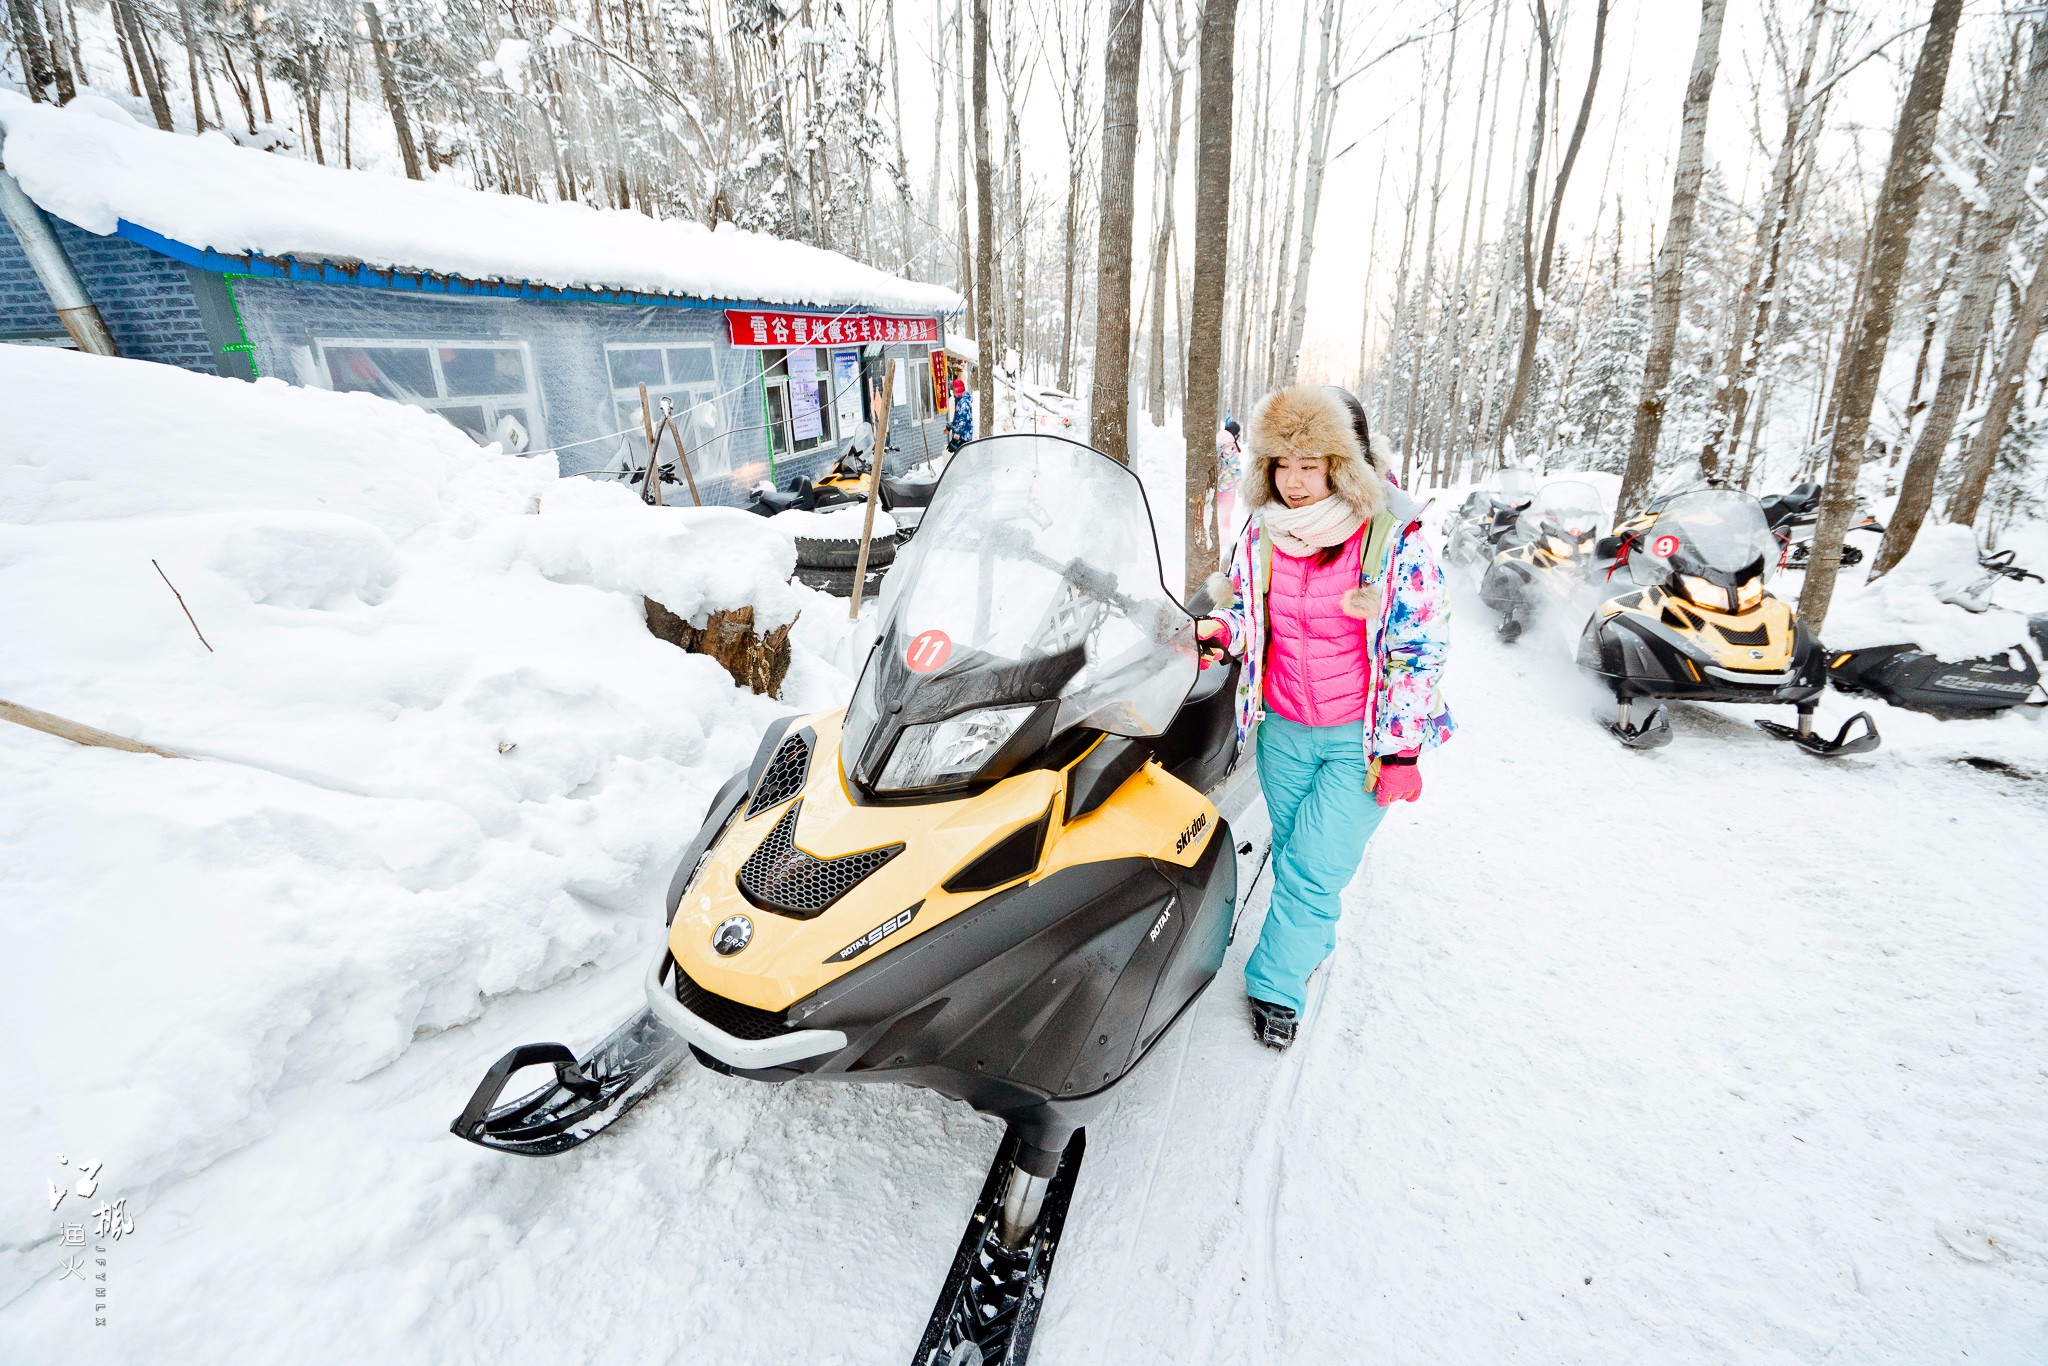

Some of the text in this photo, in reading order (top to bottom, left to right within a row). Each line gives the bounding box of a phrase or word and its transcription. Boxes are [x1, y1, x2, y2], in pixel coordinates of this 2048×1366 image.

[750, 315, 928, 343] 雪谷雪地摩托车义务救援队
[1658, 538, 1673, 556] 9
[913, 635, 945, 667] 11
[1176, 812, 1206, 855] ski-doo
[724, 935, 745, 948] BRP
[840, 909, 911, 958] ROTAX 550
[1150, 909, 1170, 942] ROTAX
